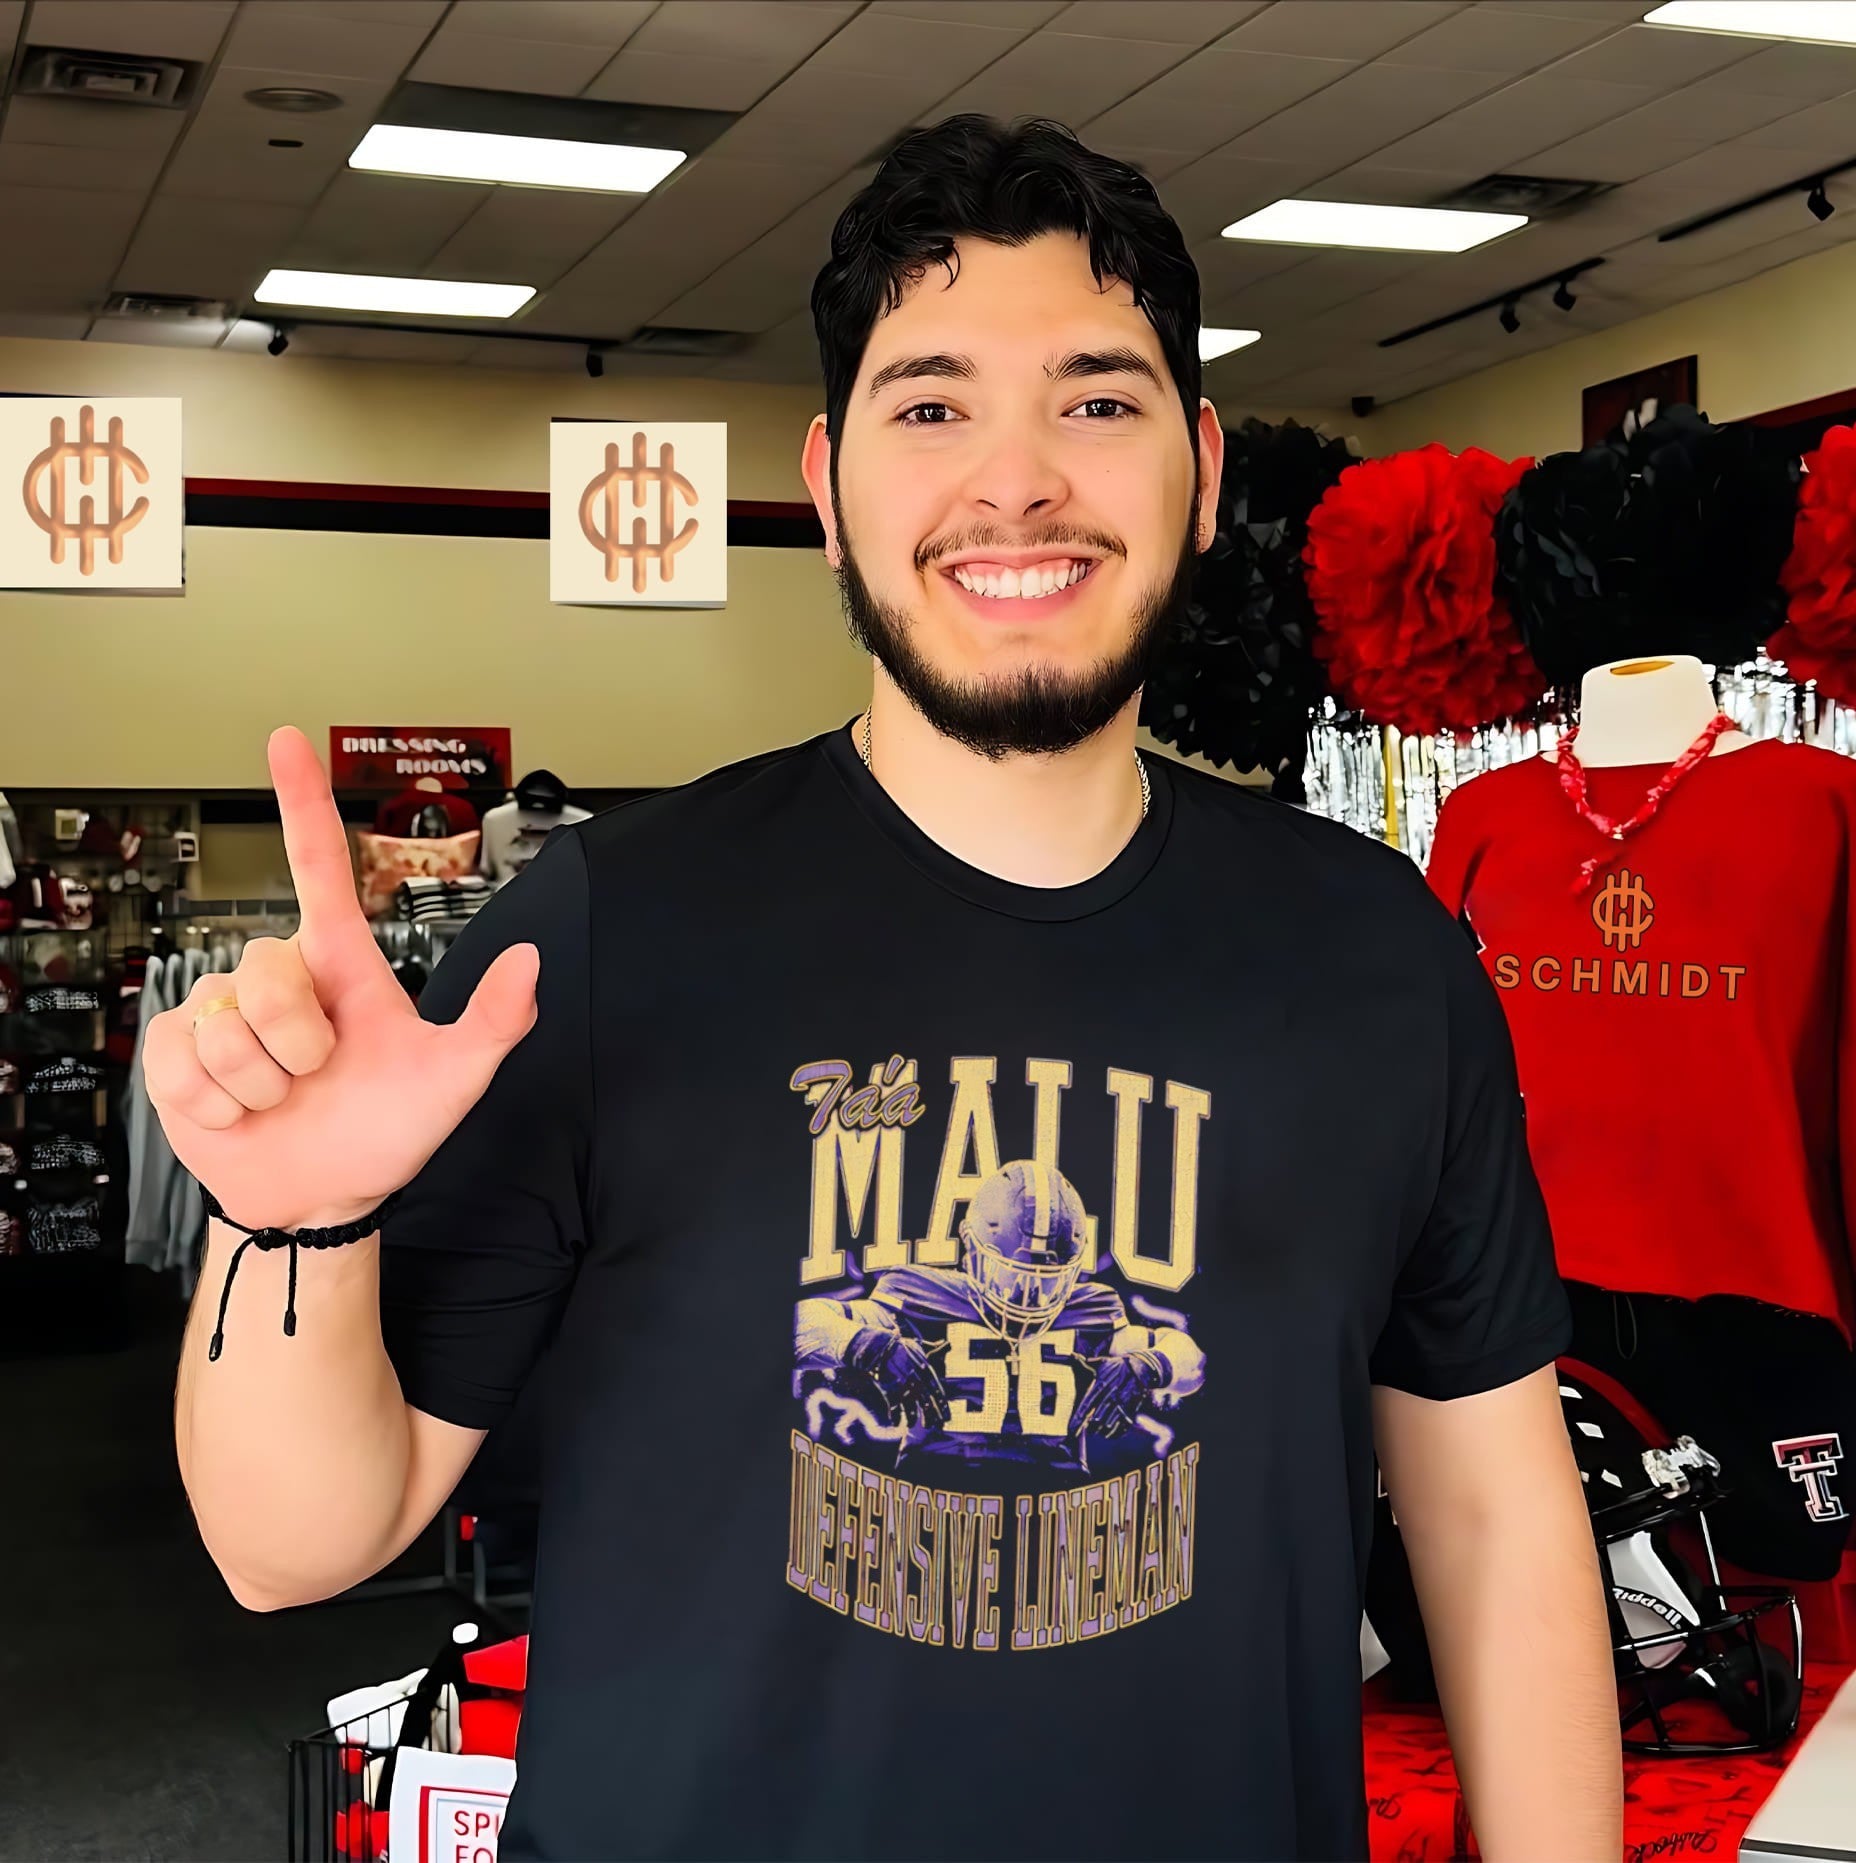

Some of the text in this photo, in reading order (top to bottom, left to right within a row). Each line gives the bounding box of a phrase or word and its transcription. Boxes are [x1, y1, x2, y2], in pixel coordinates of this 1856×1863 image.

[396, 758, 487, 775] ROOMS
[1494, 954, 1746, 1001] SCHMIDT
[799, 1055, 1212, 1292] MALU
[942, 1321, 1077, 1436] 56
[786, 1428, 1200, 1651] DEFENSIVE LINEMAN
